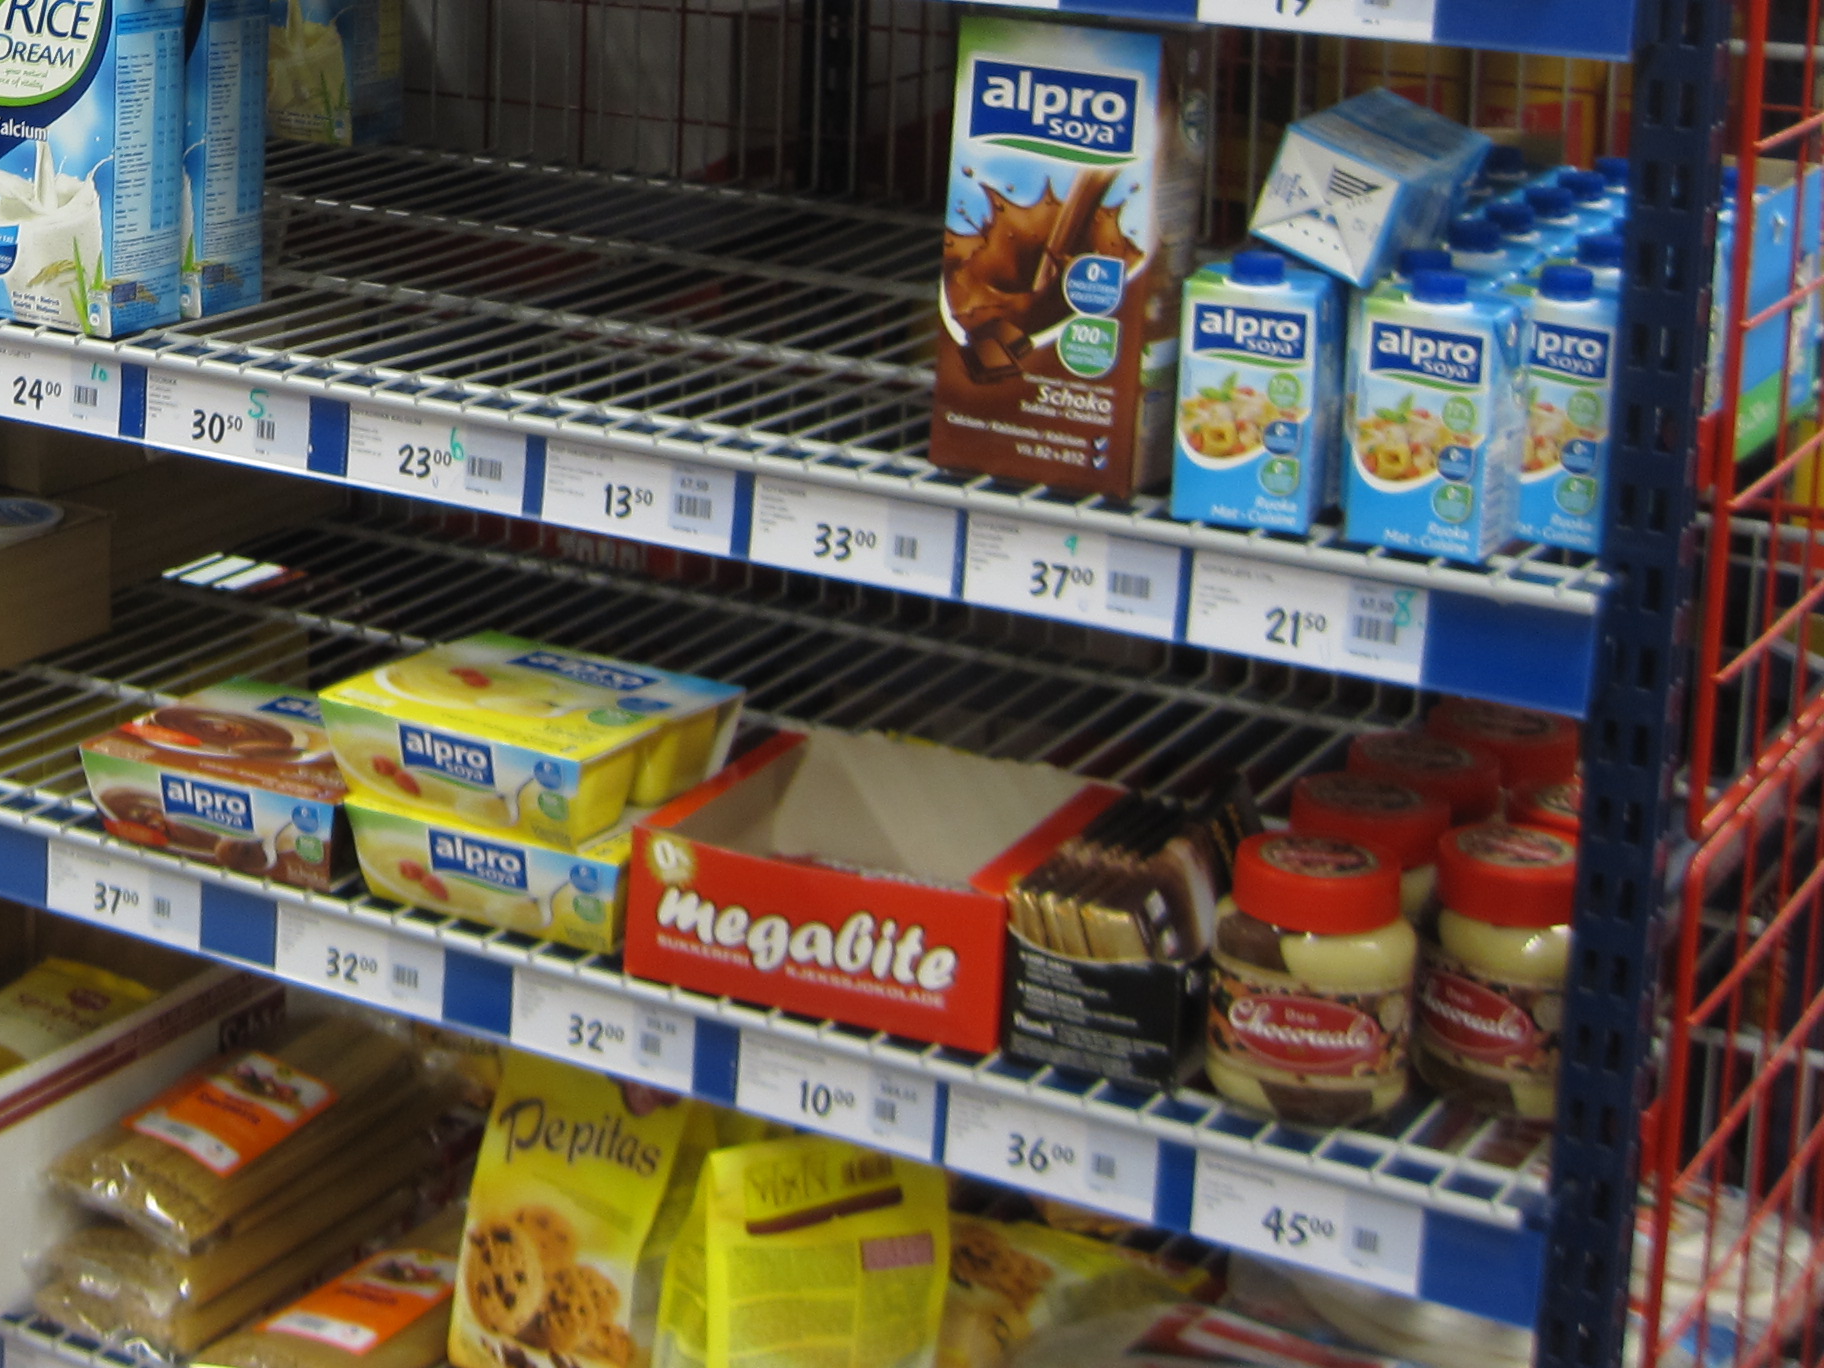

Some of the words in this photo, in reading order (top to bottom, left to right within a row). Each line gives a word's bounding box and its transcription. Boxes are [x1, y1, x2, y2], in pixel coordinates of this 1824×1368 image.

[982, 69, 1128, 126] alpro
[1048, 116, 1115, 145] soya
[1200, 309, 1301, 343] alpro
[1245, 337, 1294, 357] soya
[1376, 329, 1477, 365] alpro
[1422, 358, 1471, 380] soya
[1037, 385, 1112, 415] Schoko
[405, 730, 489, 769] alpro
[443, 762, 486, 783] soya
[166, 779, 248, 816] alpro
[202, 807, 245, 828] soya
[435, 836, 522, 874] alpro
[656, 885, 958, 992] megabite
[500, 1094, 663, 1178] Pepitas
